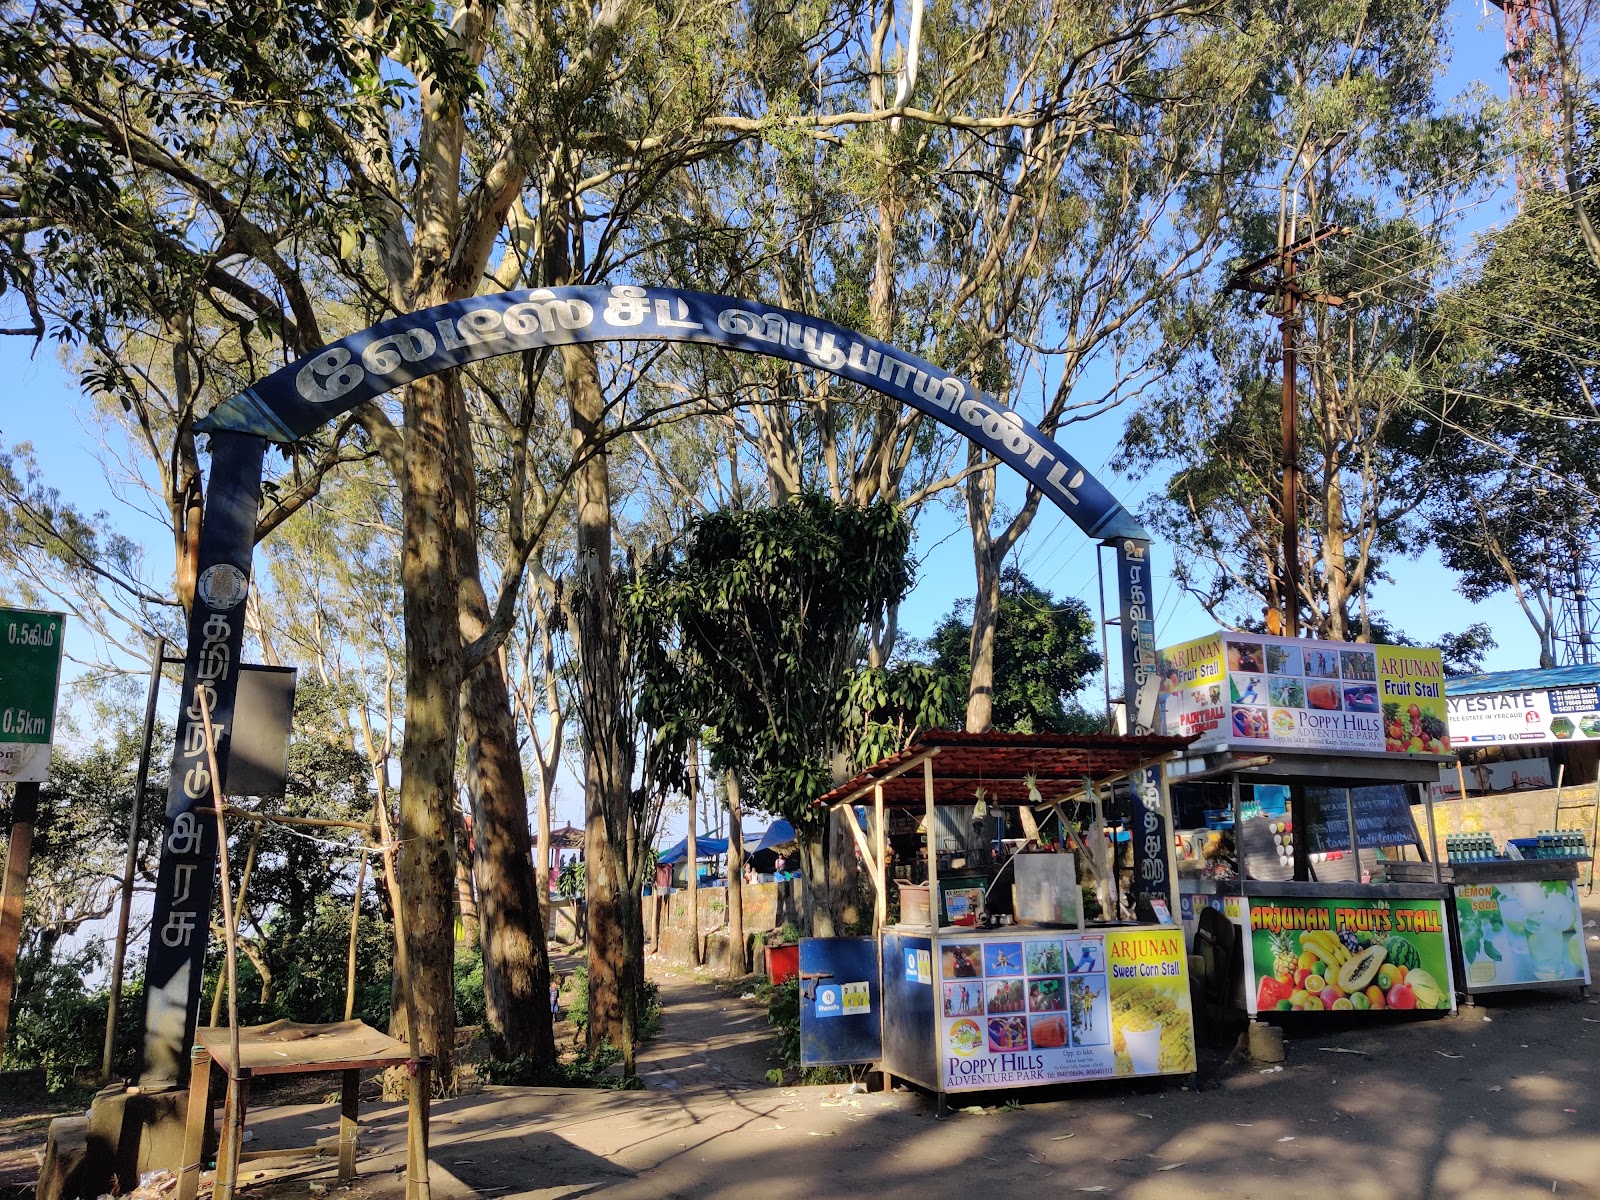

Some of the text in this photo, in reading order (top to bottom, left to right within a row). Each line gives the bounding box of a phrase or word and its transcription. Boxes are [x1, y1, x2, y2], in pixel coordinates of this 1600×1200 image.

[1172, 640, 1221, 668] ARJUNAN
[1178, 661, 1219, 682] Fruit Stall
[1381, 657, 1440, 678] ARJUNAN
[1384, 679, 1440, 698] Fruit Stall
[1466, 693, 1535, 712] ESTATE
[1297, 728, 1381, 741] ADVENTURE PARK
[1458, 887, 1492, 898] LEMON
[1472, 900, 1498, 911] SODA
[1250, 906, 1442, 935] ARJUNAN FRUITS STALL
[1111, 938, 1179, 962] ARJUNAN
[1112, 961, 1180, 978] Sweet Corn Stall
[946, 1069, 1045, 1087] ADVENTURE PARK
